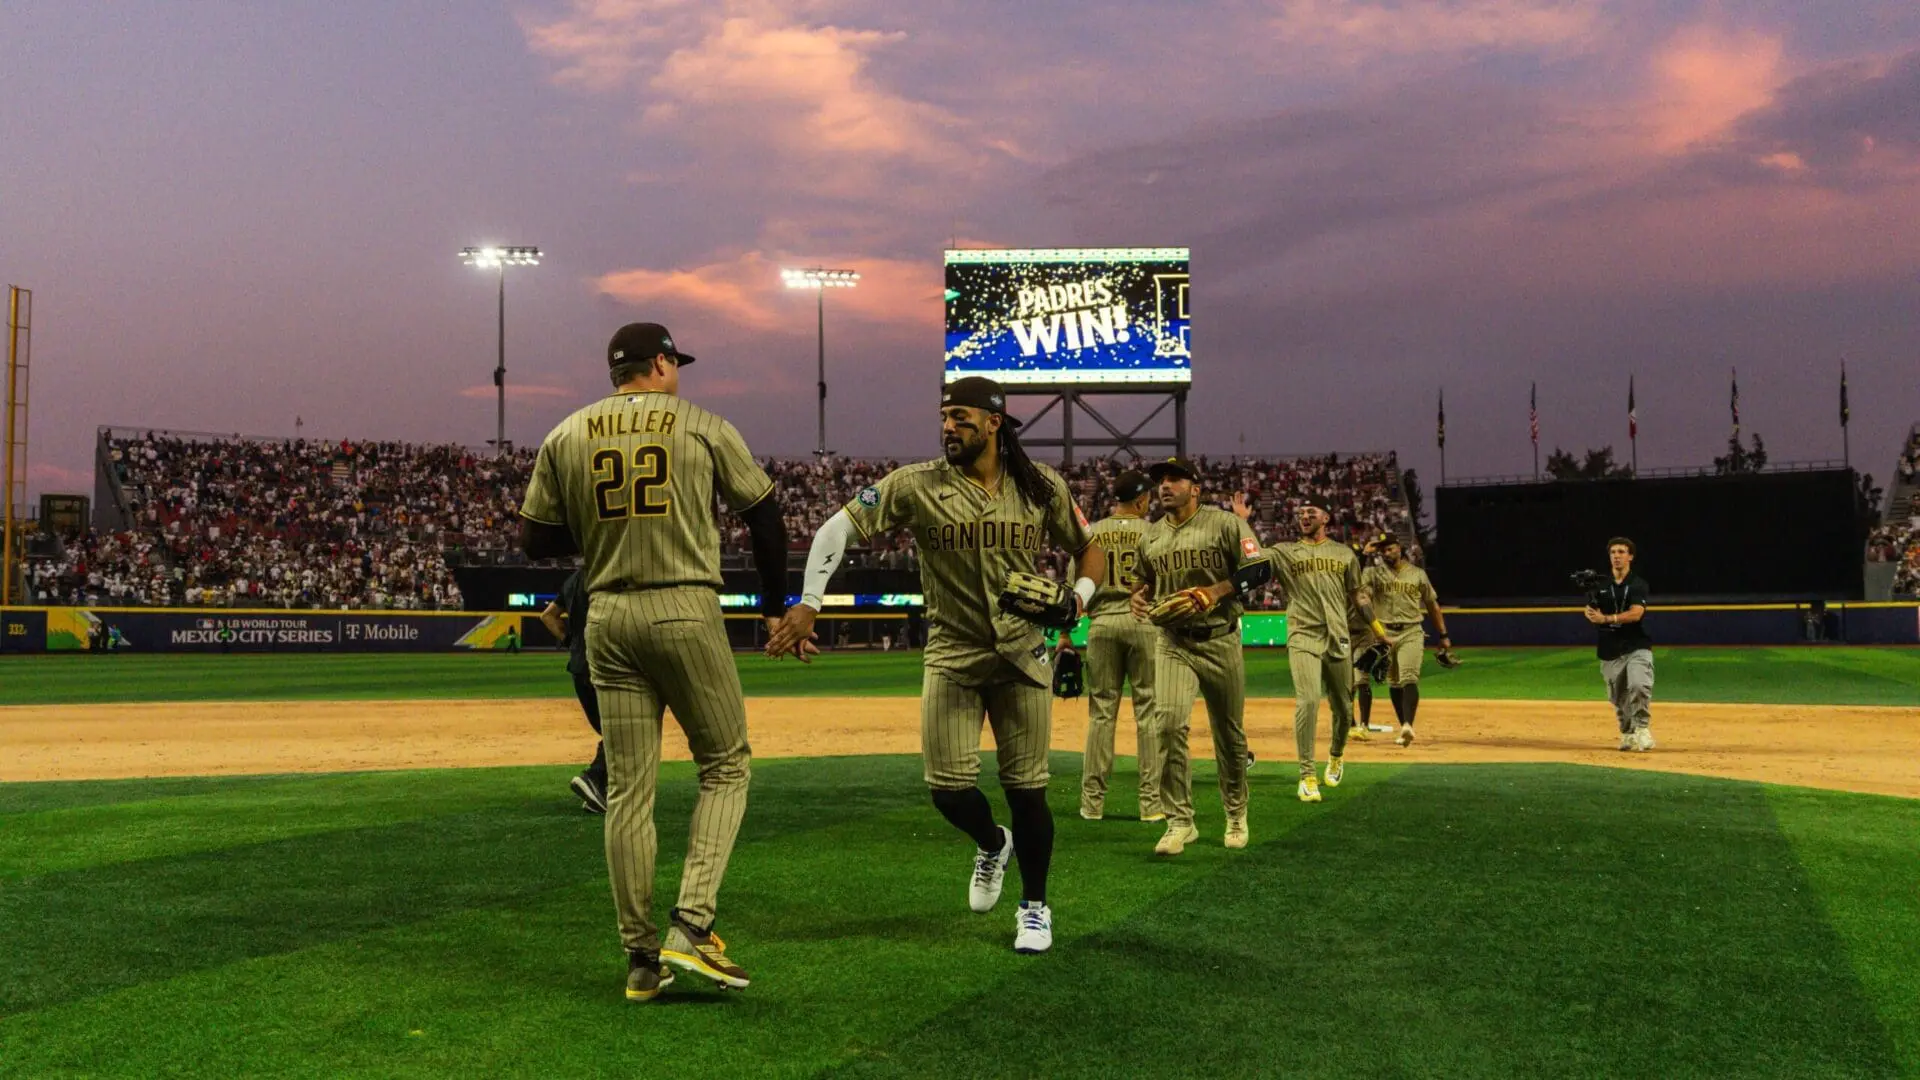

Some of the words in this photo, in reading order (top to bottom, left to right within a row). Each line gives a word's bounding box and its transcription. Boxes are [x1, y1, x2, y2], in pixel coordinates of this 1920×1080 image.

[1018, 278, 1112, 315] PADRES
[1010, 305, 1128, 357] WIN!
[587, 409, 676, 440] MILLER
[592, 444, 671, 521] 22
[927, 521, 975, 551] SAN
[1091, 531, 1142, 546] MACHA
[1107, 550, 1136, 587] 13
[1172, 549, 1223, 570] DIEGO
[1290, 558, 1314, 577] SAN
[1315, 557, 1345, 574] DIEG
[239, 629, 276, 643] CITY
[277, 629, 333, 643] SERIES
[241, 619, 278, 629] WORLD
[279, 619, 307, 629] TOUR
[364, 623, 419, 640] Mobile
